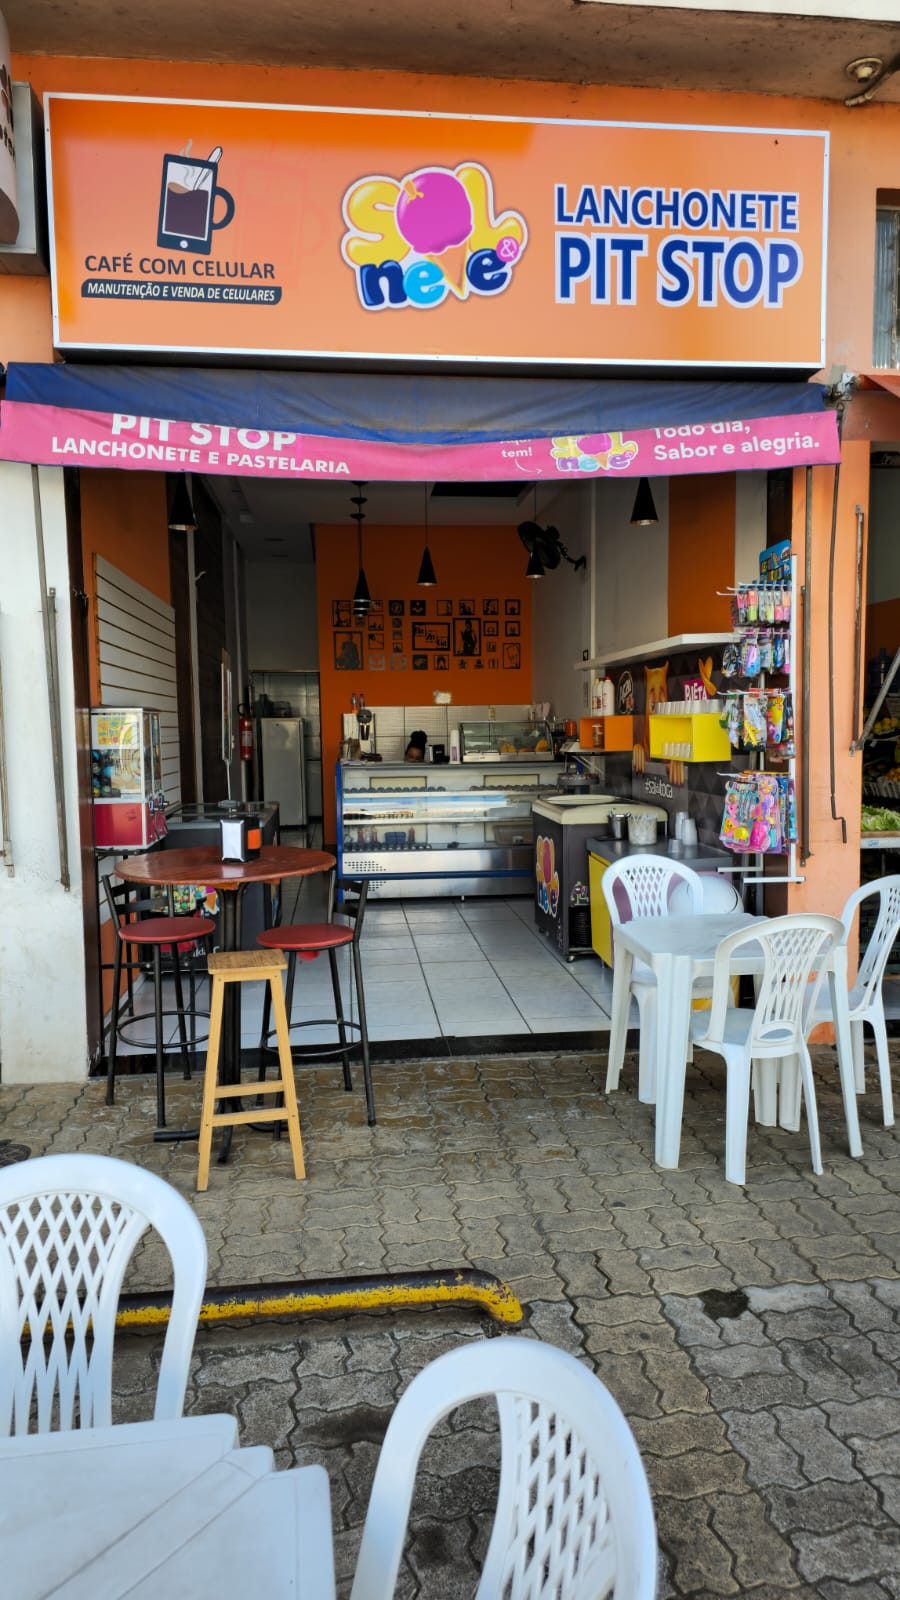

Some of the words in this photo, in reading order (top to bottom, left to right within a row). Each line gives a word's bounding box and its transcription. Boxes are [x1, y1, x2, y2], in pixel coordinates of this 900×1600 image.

[556, 185, 799, 231] LANCHONETE
[85, 253, 133, 273] CAFÉ
[139, 257, 186, 276] COM
[192, 260, 276, 280] CELULAR
[557, 234, 646, 303] PIT
[659, 237, 801, 306] STOP
[87, 282, 161, 299] MANUTENÇÃO
[162, 285, 169, 297] E
[171, 286, 205, 299] VENDA
[207, 287, 220, 300] DE
[222, 288, 275, 302] CELULARES
[111, 412, 176, 442] PIT
[189, 423, 298, 452] STOP
[654, 423, 706, 440] Todo
[51, 436, 201, 464] LANCHONETE
[207, 451, 220, 465] E
[226, 452, 351, 475] PASTELARIA
[501, 446, 533, 458] tem!
[653, 442, 717, 461] Sabor
[722, 443, 735, 455] e
[740, 432, 820, 456] alegria.
